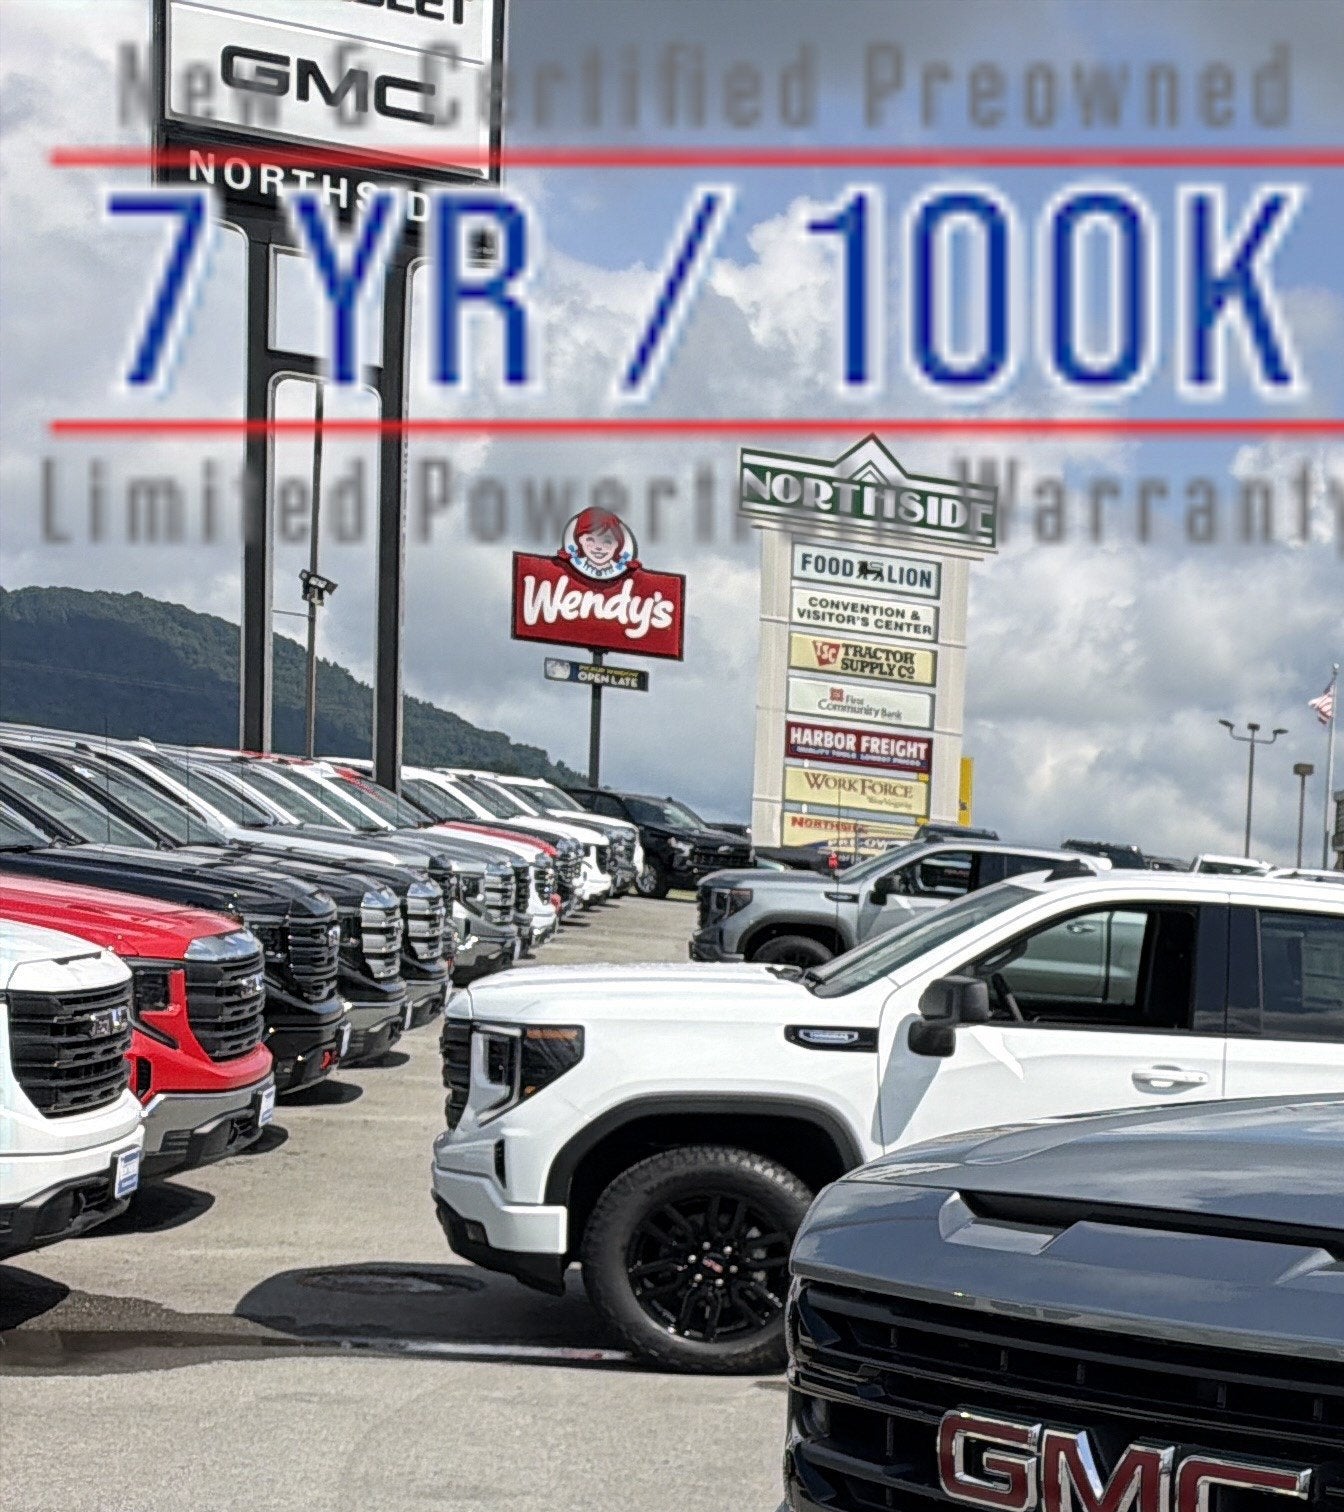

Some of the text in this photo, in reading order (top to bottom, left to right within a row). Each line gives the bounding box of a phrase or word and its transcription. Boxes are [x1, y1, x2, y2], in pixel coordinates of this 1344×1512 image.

[221, 45, 436, 126] GMC
[188, 149, 450, 226] NORTHSD
[742, 467, 995, 534] NORTHSIDE
[801, 552, 933, 590] FOOD LION
[523, 575, 675, 639] Wendy's
[797, 607, 933, 636] VISITOR'S CENTER
[807, 595, 921, 621] CONVENTION &
[814, 641, 838, 664] TSC
[841, 643, 915, 665] TRACTOR
[578, 671, 638, 688] OPEN LATE
[841, 658, 897, 677] SUPPLY
[817, 698, 881, 718] Community
[789, 726, 857, 752] HARBOR
[860, 735, 929, 761] FREIGHT
